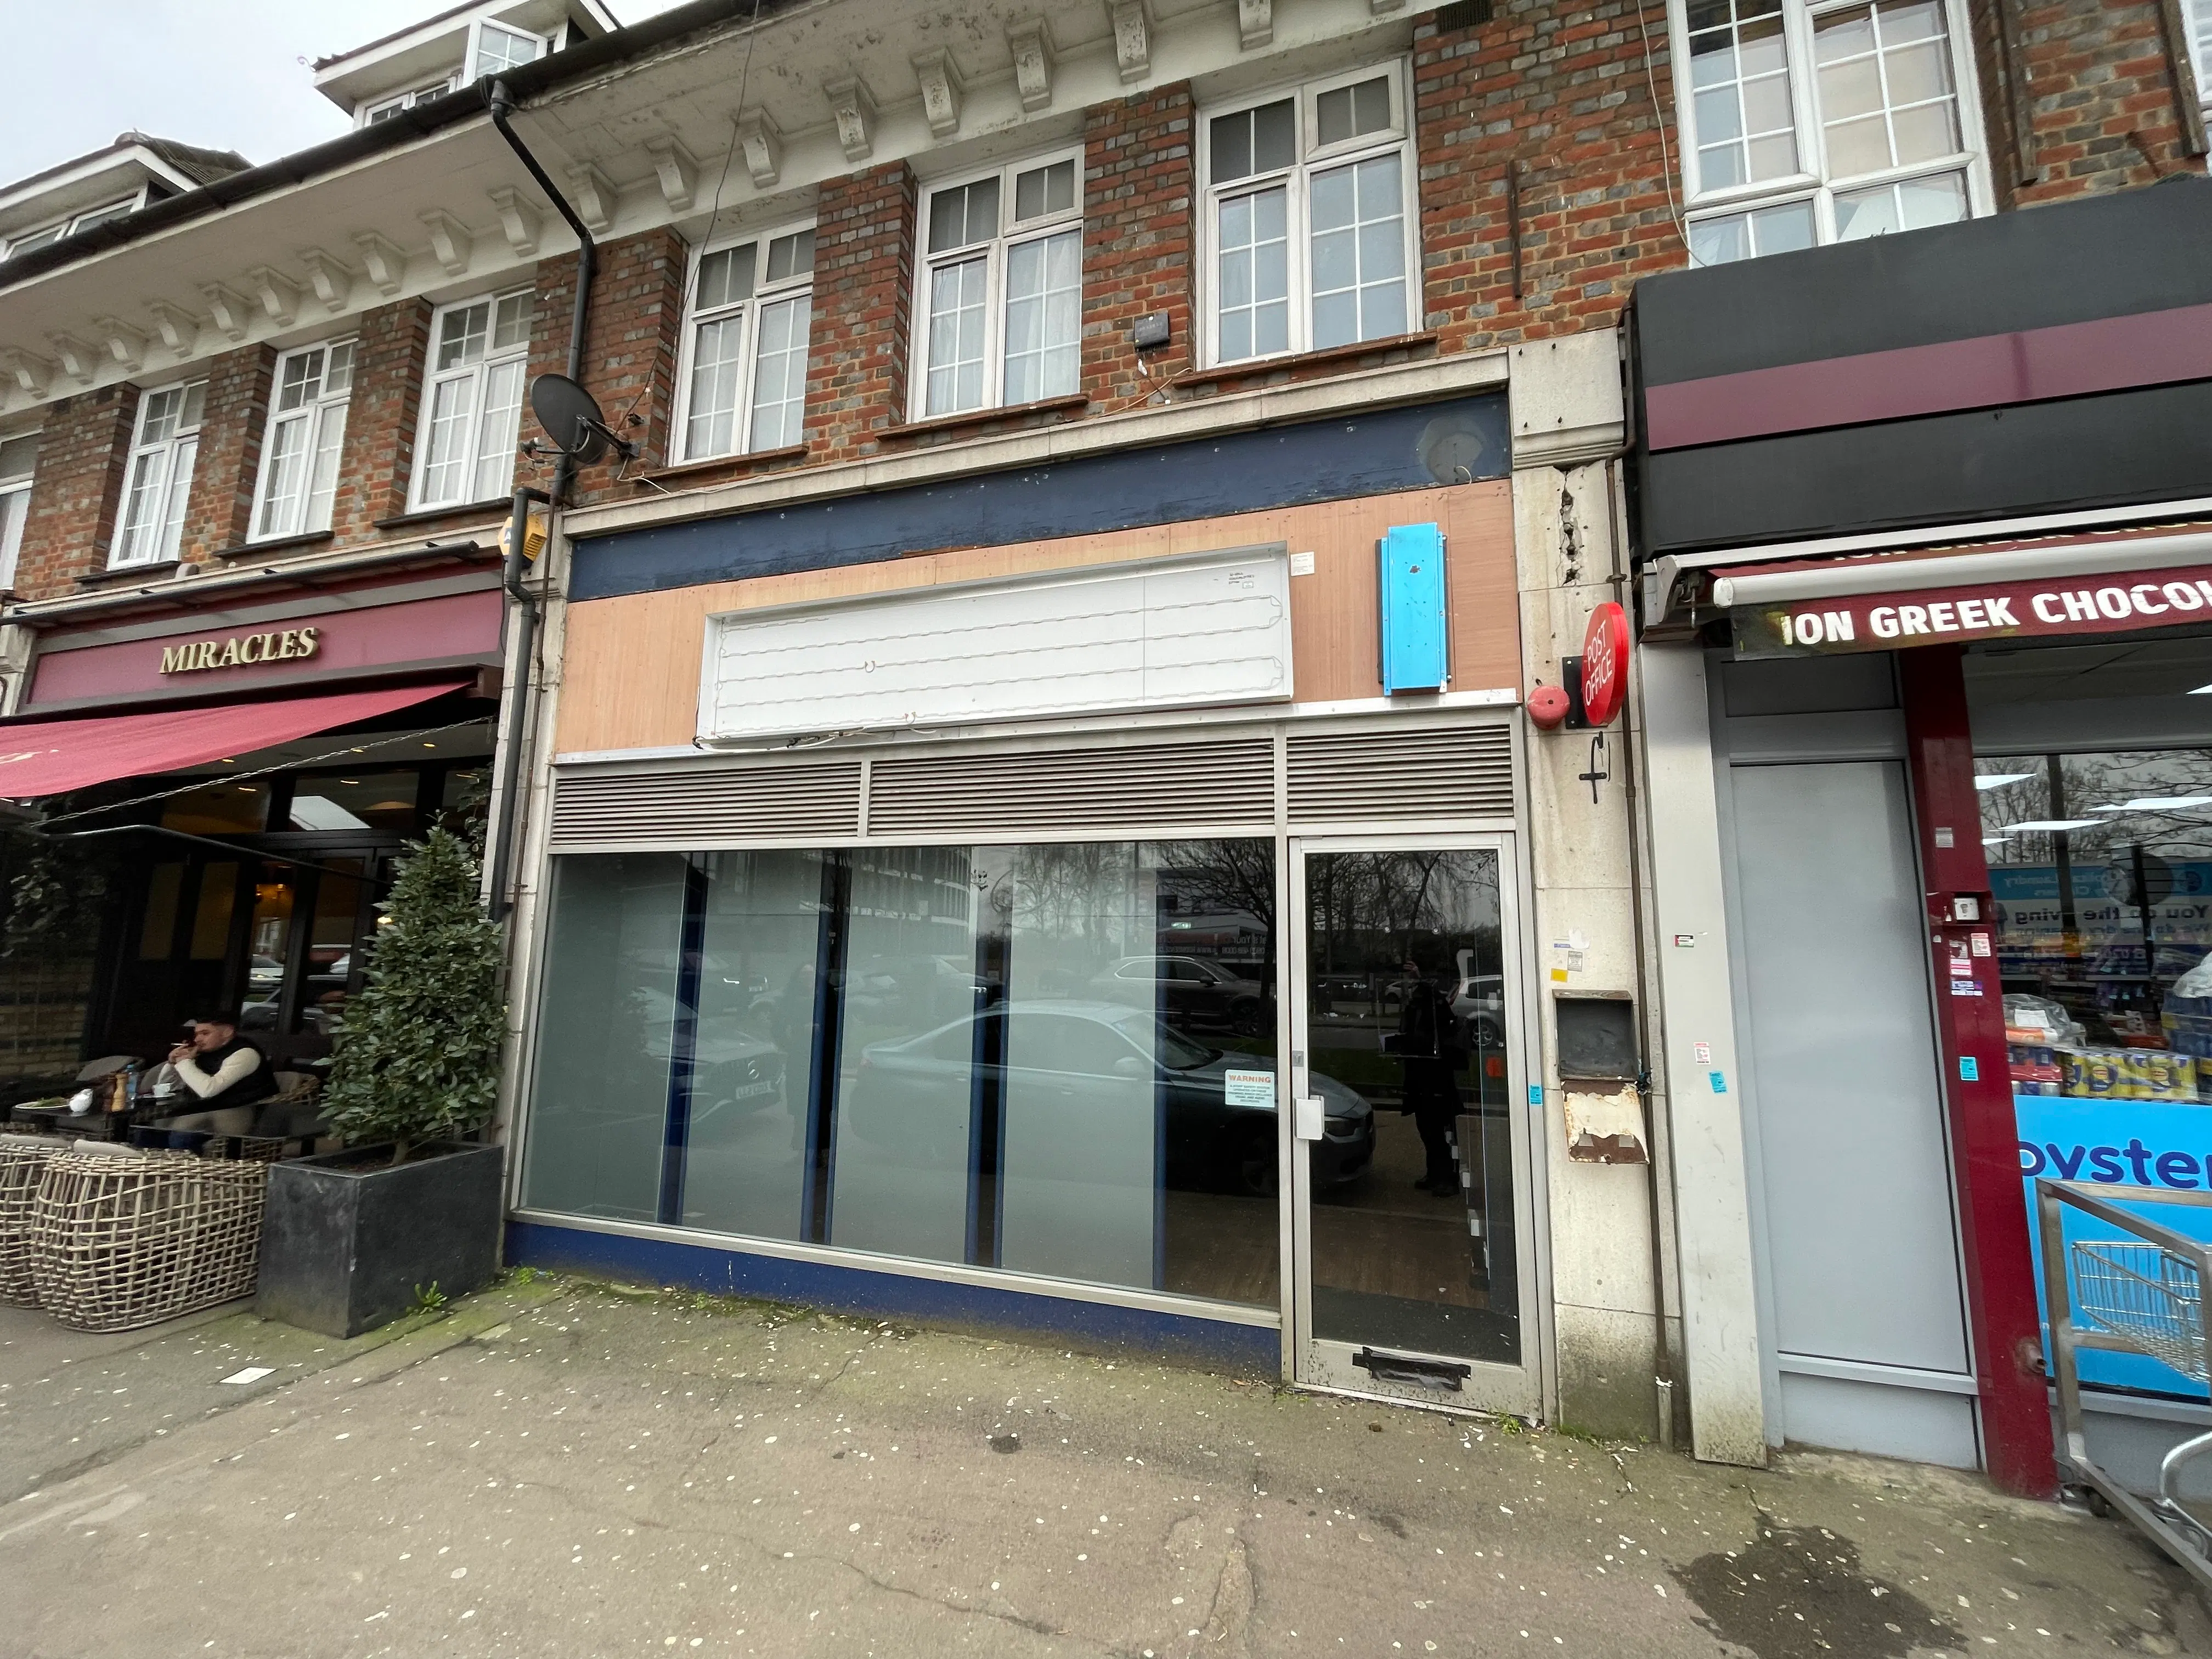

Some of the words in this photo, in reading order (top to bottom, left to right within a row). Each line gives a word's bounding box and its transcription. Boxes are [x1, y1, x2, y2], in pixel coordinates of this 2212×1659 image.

[1587, 619, 1606, 672] POST
[1779, 610, 1854, 646] ION
[1870, 597, 2021, 639] GREEK
[159, 627, 318, 673] MIRACLES
[1585, 648, 1613, 706] OFFICE
[1229, 1075, 1271, 1083] WARNING
[2019, 1138, 2212, 1189] oyste
